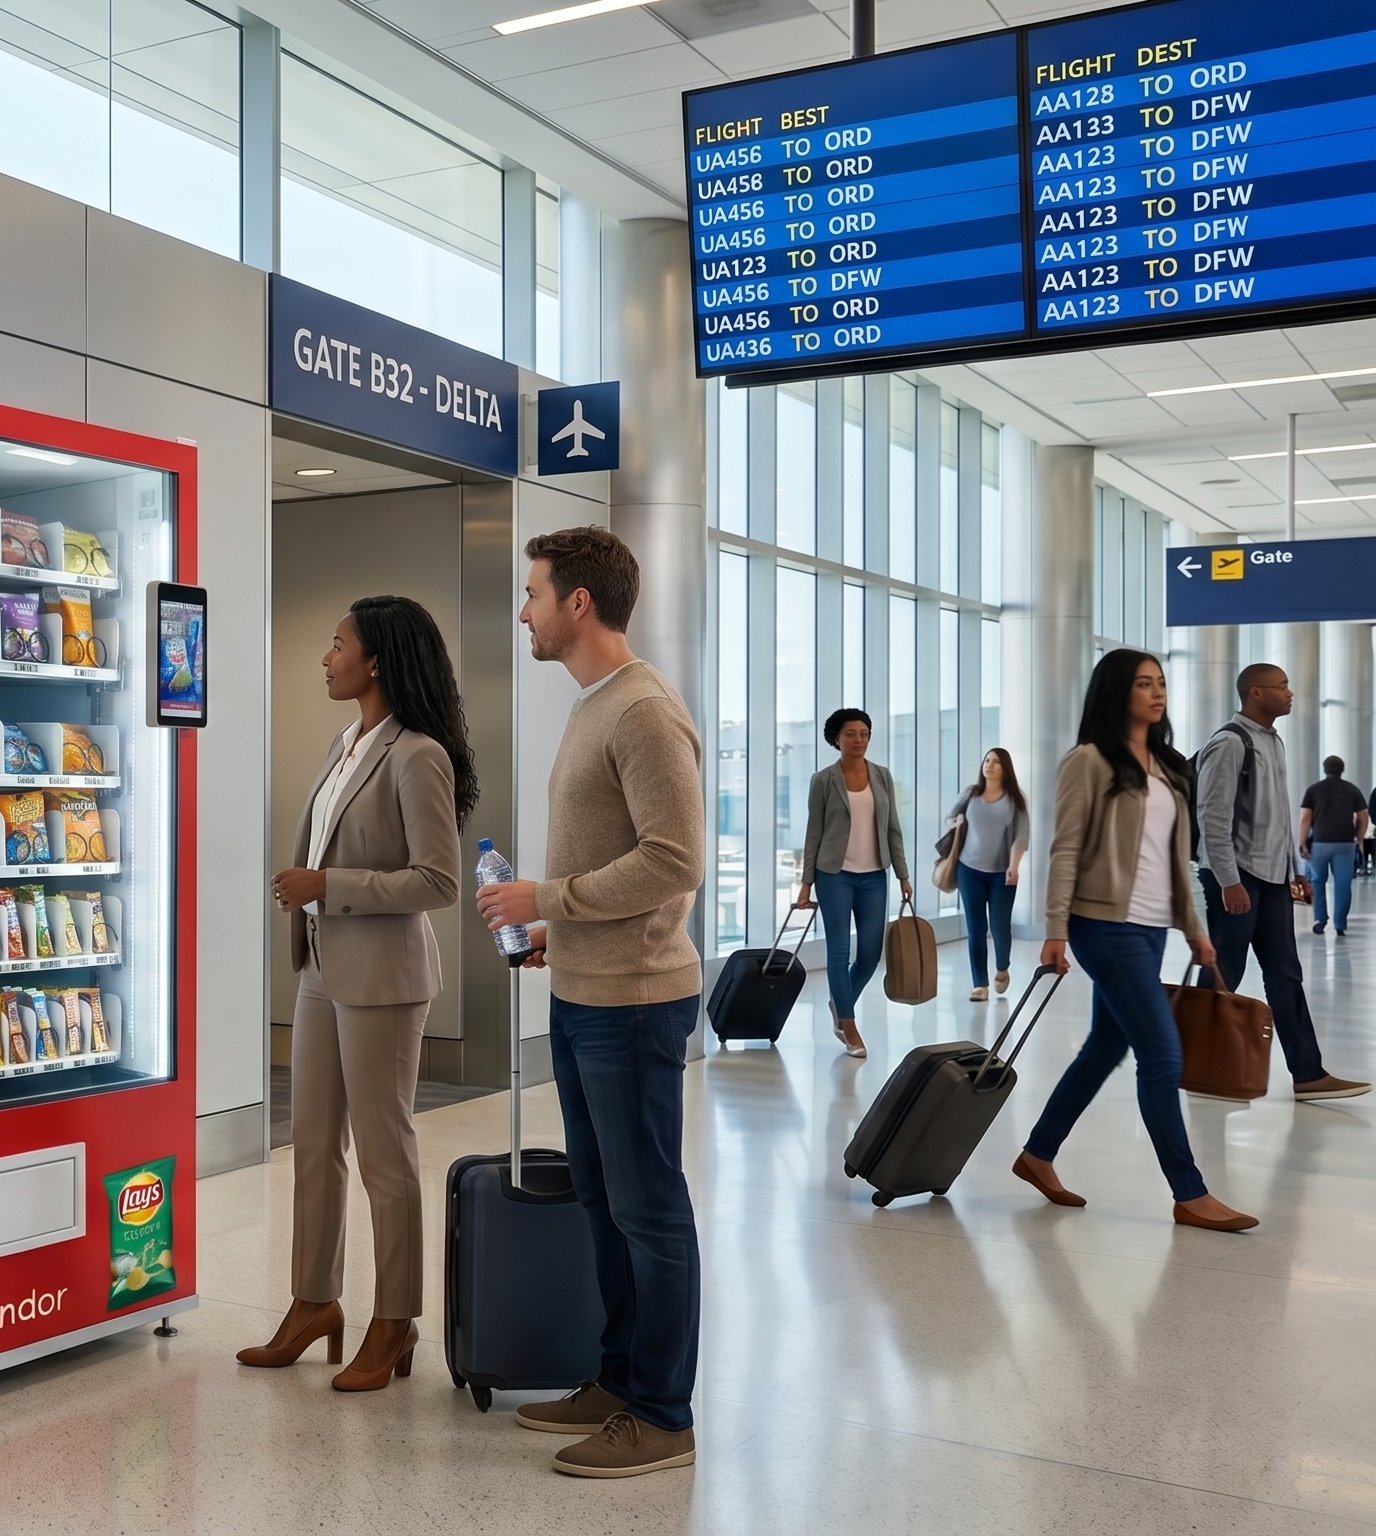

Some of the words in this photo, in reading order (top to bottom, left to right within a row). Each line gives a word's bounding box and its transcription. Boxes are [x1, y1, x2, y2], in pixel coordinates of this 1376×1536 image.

[1036, 53, 1116, 85] FLIGHT
[1137, 38, 1197, 67] DEST
[1139, 74, 1174, 97] TO
[1190, 61, 1247, 89] ORD
[695, 117, 763, 146] FLIGHT
[780, 105, 830, 130] BEST
[1036, 114, 1115, 146] AA133
[1139, 105, 1174, 128] TO
[1191, 90, 1252, 120] DFW
[696, 145, 762, 173] UA456
[781, 137, 811, 159] TO
[824, 127, 872, 151] ORD
[782, 165, 812, 186] TO
[826, 155, 873, 179] ORD
[1037, 145, 1115, 175] AA123
[1139, 135, 1175, 158] TO
[1192, 121, 1253, 151] DFW
[1038, 175, 1117, 205] AA123
[1140, 166, 1176, 189] TO
[1192, 153, 1249, 181] DFW
[699, 200, 765, 227] UA456
[783, 193, 813, 213] TO
[827, 183, 874, 207] ORD
[1039, 205, 1118, 234] AA123
[1141, 196, 1176, 219] TO
[1193, 183, 1254, 212] DFW
[701, 227, 766, 254] UA456
[785, 221, 815, 242] TO
[828, 212, 876, 235] ORD
[1040, 235, 1119, 264] AA123
[1142, 226, 1177, 249] TO
[1193, 215, 1249, 242] DFW
[702, 255, 767, 281] UA123
[786, 249, 816, 269] TO
[829, 240, 877, 263] ORD
[1041, 265, 1119, 293] AA123
[1143, 257, 1178, 279] TO
[1194, 245, 1255, 273] DFW
[703, 282, 770, 308] UA456
[788, 276, 818, 297] TO
[831, 267, 882, 292] DFW
[1043, 294, 1120, 323] AA123
[1144, 287, 1179, 309] TO
[1195, 277, 1255, 304] DFW
[705, 310, 771, 335] UA456
[789, 304, 819, 324] TO
[832, 296, 880, 319] ORD
[706, 337, 772, 362] UA436
[791, 332, 821, 352] TO
[833, 325, 881, 347] ORD
[293, 327, 362, 388] GATE
[370, 352, 414, 404] B32
[435, 374, 503, 433] DELTA
[1250, 550, 1293, 565] Gate
